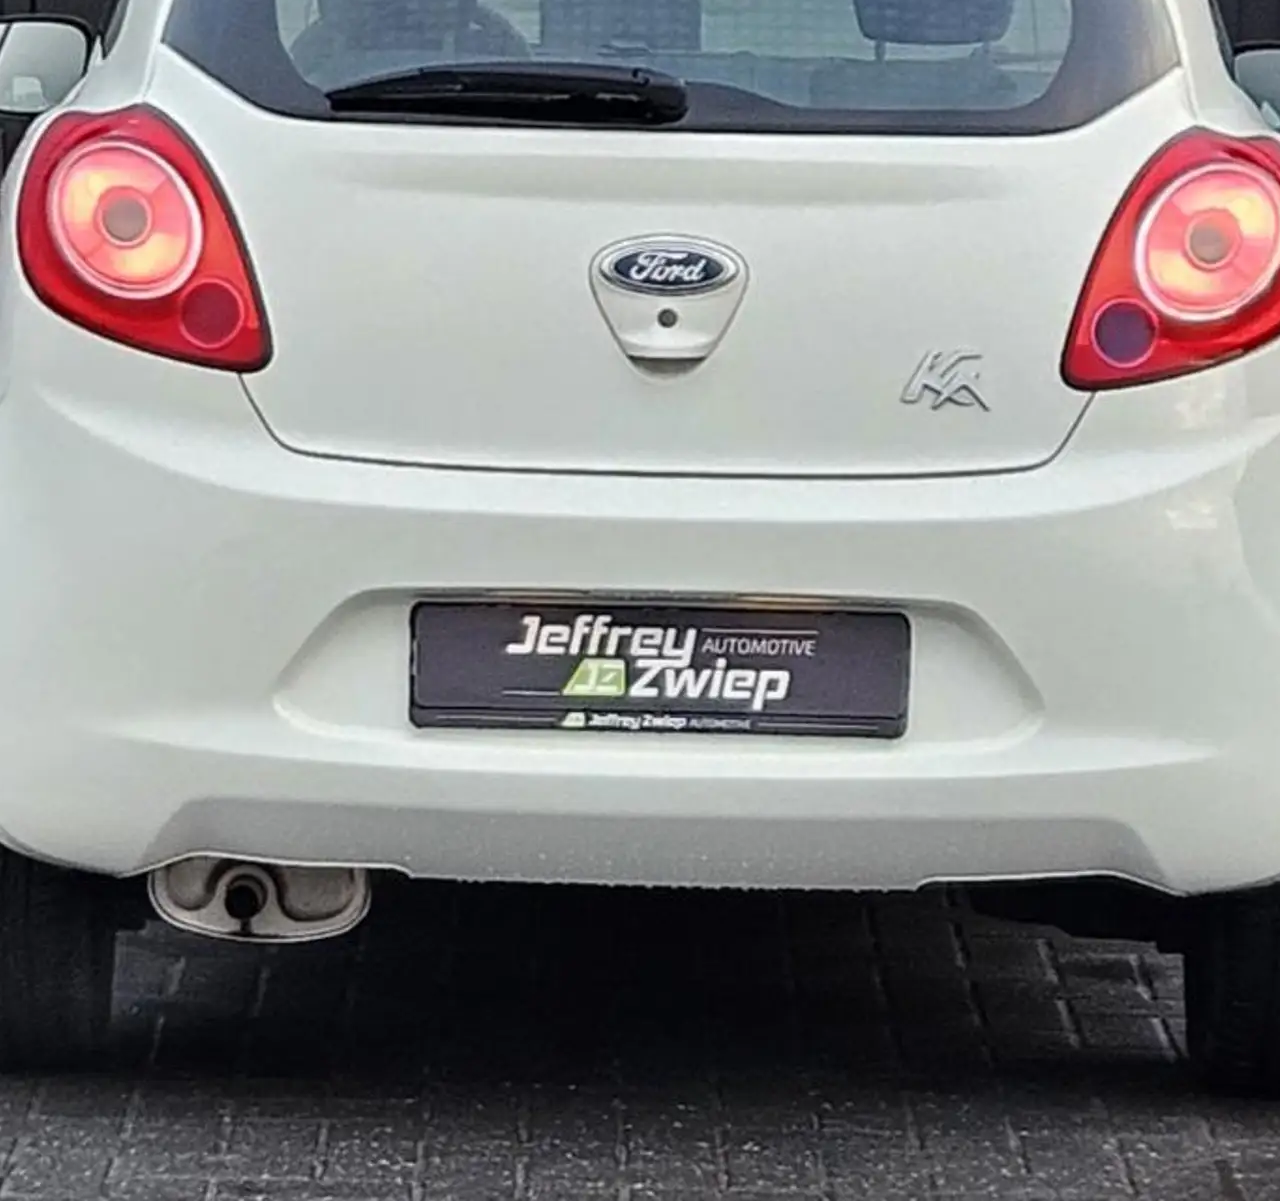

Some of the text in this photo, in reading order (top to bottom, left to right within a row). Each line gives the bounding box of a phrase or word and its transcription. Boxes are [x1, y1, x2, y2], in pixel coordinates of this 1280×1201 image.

[628, 249, 705, 285] Ford
[505, 614, 818, 668] Jeffrey AUTOMOTIVE
[629, 658, 791, 712] Zwiep
